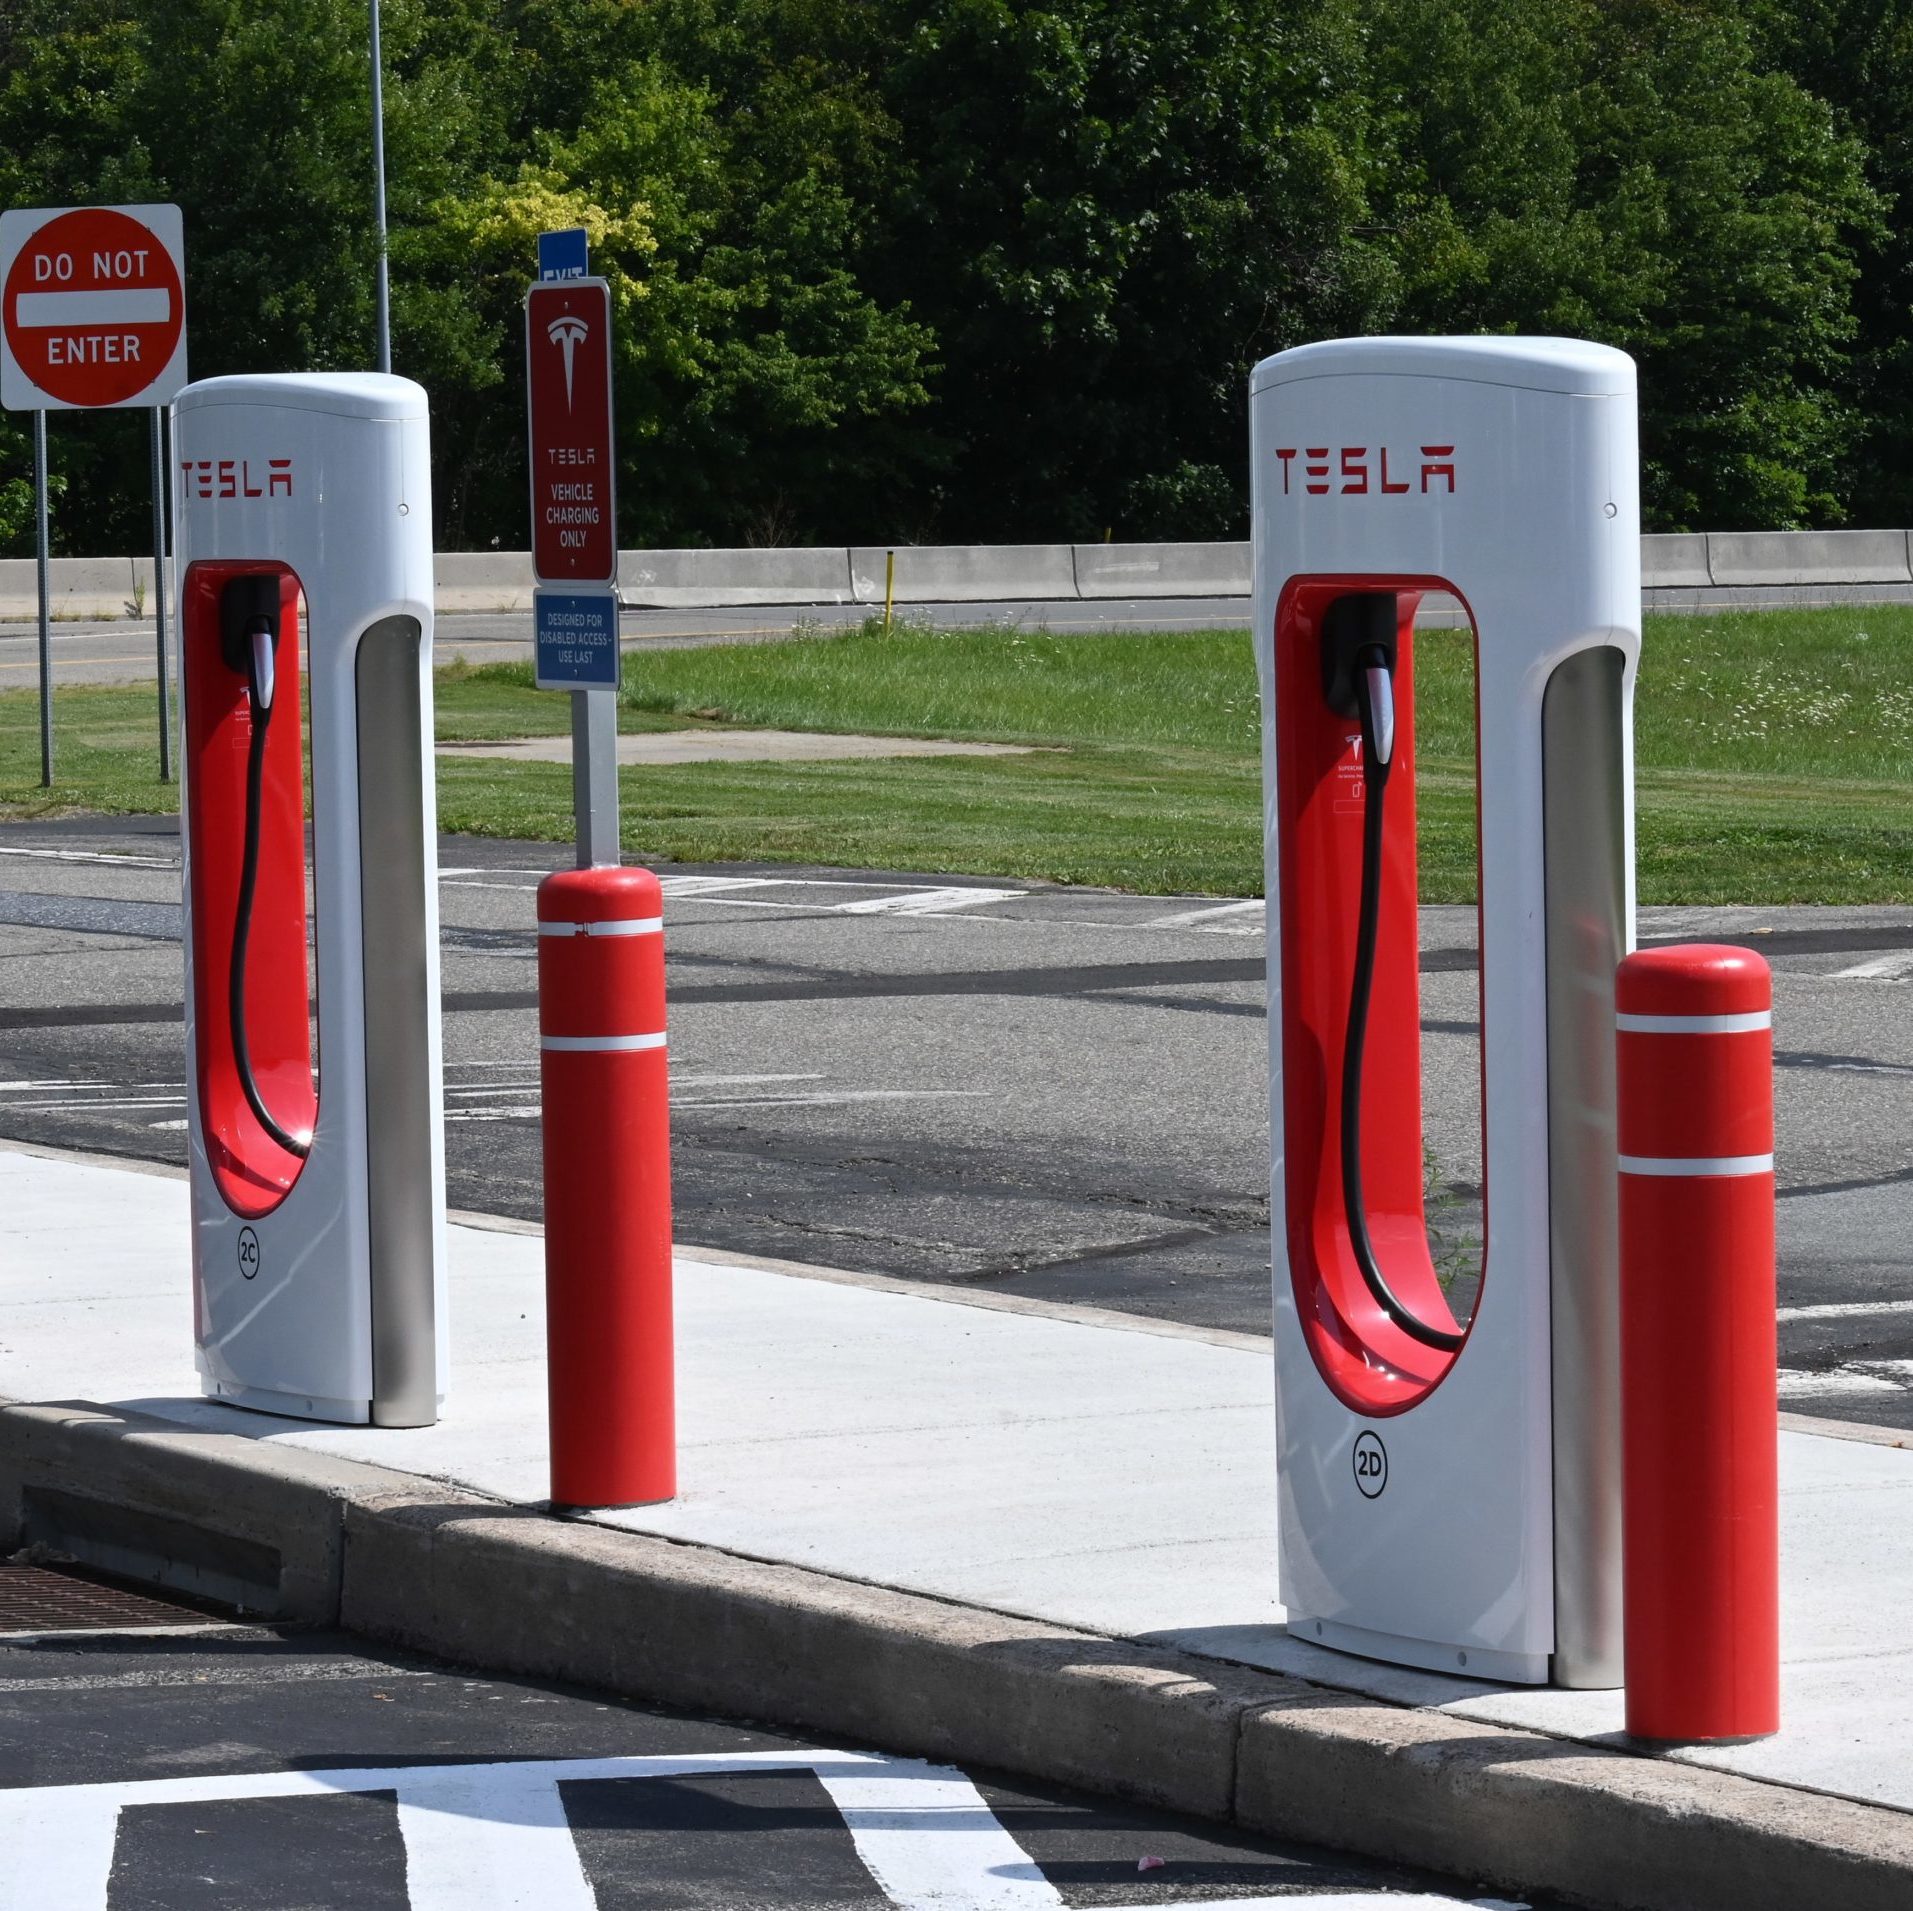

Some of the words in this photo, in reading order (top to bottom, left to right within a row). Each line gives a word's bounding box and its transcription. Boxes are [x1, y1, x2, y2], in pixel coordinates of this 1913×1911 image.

[34, 253, 73, 281] DO
[93, 250, 149, 279] NOT
[48, 335, 140, 365] ENTER
[548, 448, 595, 465] TESLA
[181, 459, 292, 499] TESLA
[1275, 446, 1455, 495] TESLA
[551, 483, 593, 501] VEHICLE
[546, 507, 600, 524] CHARGING
[560, 530, 587, 547] ONLY
[547, 613, 585, 627] DESIGNED
[586, 614, 603, 627] FOR
[540, 631, 576, 645] DISABLED
[558, 650, 573, 664] USE
[574, 651, 593, 664] LAST
[241, 1241, 256, 1264] 2C
[1358, 1450, 1382, 1477] 2D
